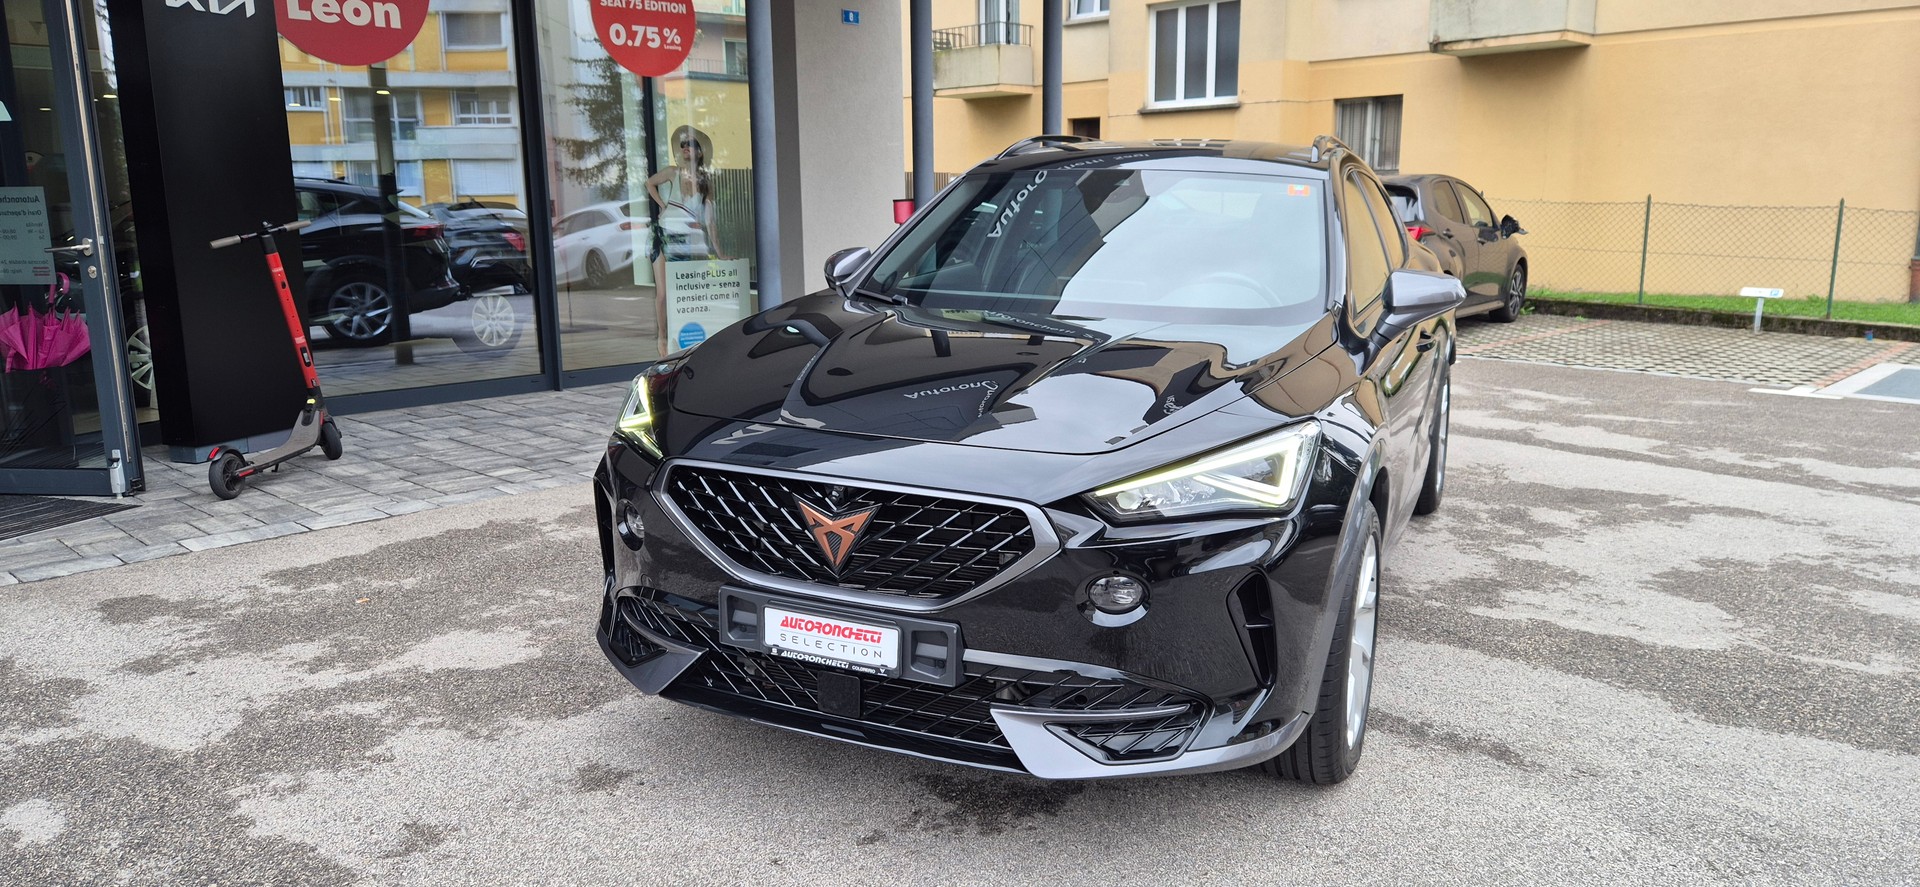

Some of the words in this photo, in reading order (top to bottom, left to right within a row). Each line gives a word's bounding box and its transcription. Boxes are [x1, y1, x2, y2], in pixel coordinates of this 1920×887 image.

[600, 0, 626, 9] SEAT
[629, 0, 642, 10] 75
[644, 0, 687, 14] EDITION
[287, 0, 402, 30] Leon
[675, 269, 727, 280] LeasingPLUS
[728, 268, 738, 277] all
[675, 282, 711, 291] inclusive
[719, 281, 741, 289] senza
[676, 294, 708, 304] pensieri
[710, 293, 730, 301] come
[732, 291, 740, 299] in
[676, 305, 711, 314] vacanza.
[780, 615, 883, 644] AUTORONCHETTI
[779, 633, 882, 659] SELECTION
